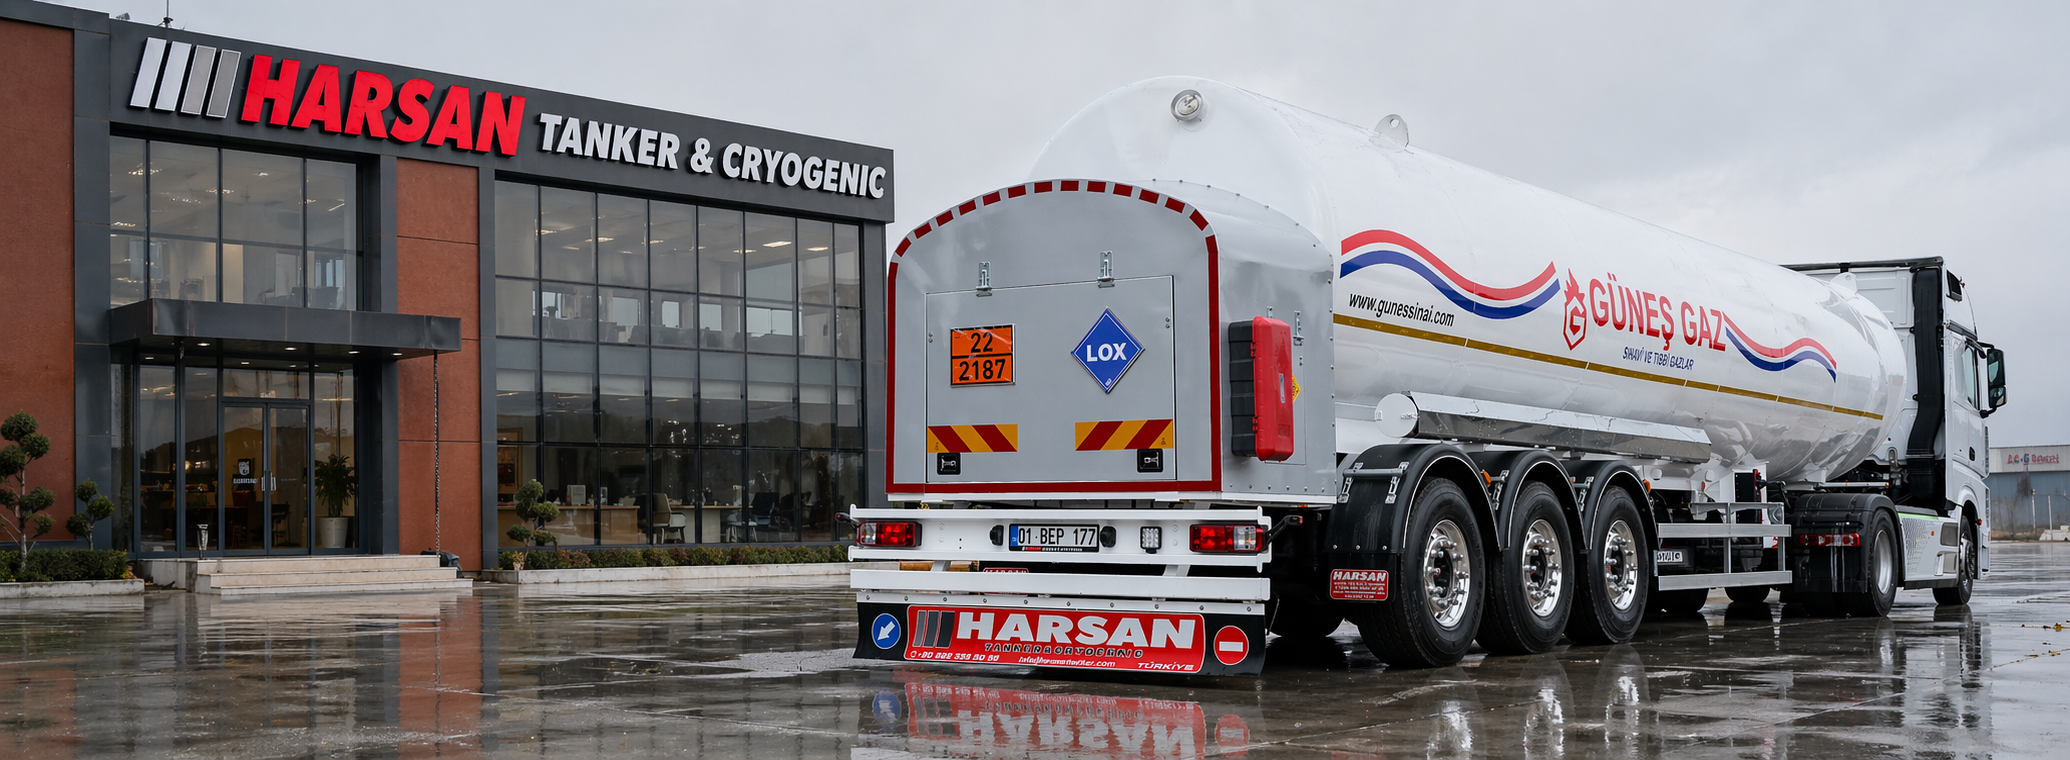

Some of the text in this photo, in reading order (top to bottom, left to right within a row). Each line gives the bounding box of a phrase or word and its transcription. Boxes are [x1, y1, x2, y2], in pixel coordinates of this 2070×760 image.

[240, 53, 887, 199] HARSAN TANKER & CRYOGENIC
[1349, 293, 1455, 327] www.gunessinai.com
[1589, 272, 1726, 352] GÜNEŞ GAZ
[970, 332, 994, 354] 22
[1086, 342, 1127, 362] LOX
[958, 358, 1006, 382] 2187
[1018, 527, 1096, 546] 01 BEP 177
[1333, 571, 1387, 582] HARSAN
[955, 611, 1196, 650] HARSAN
